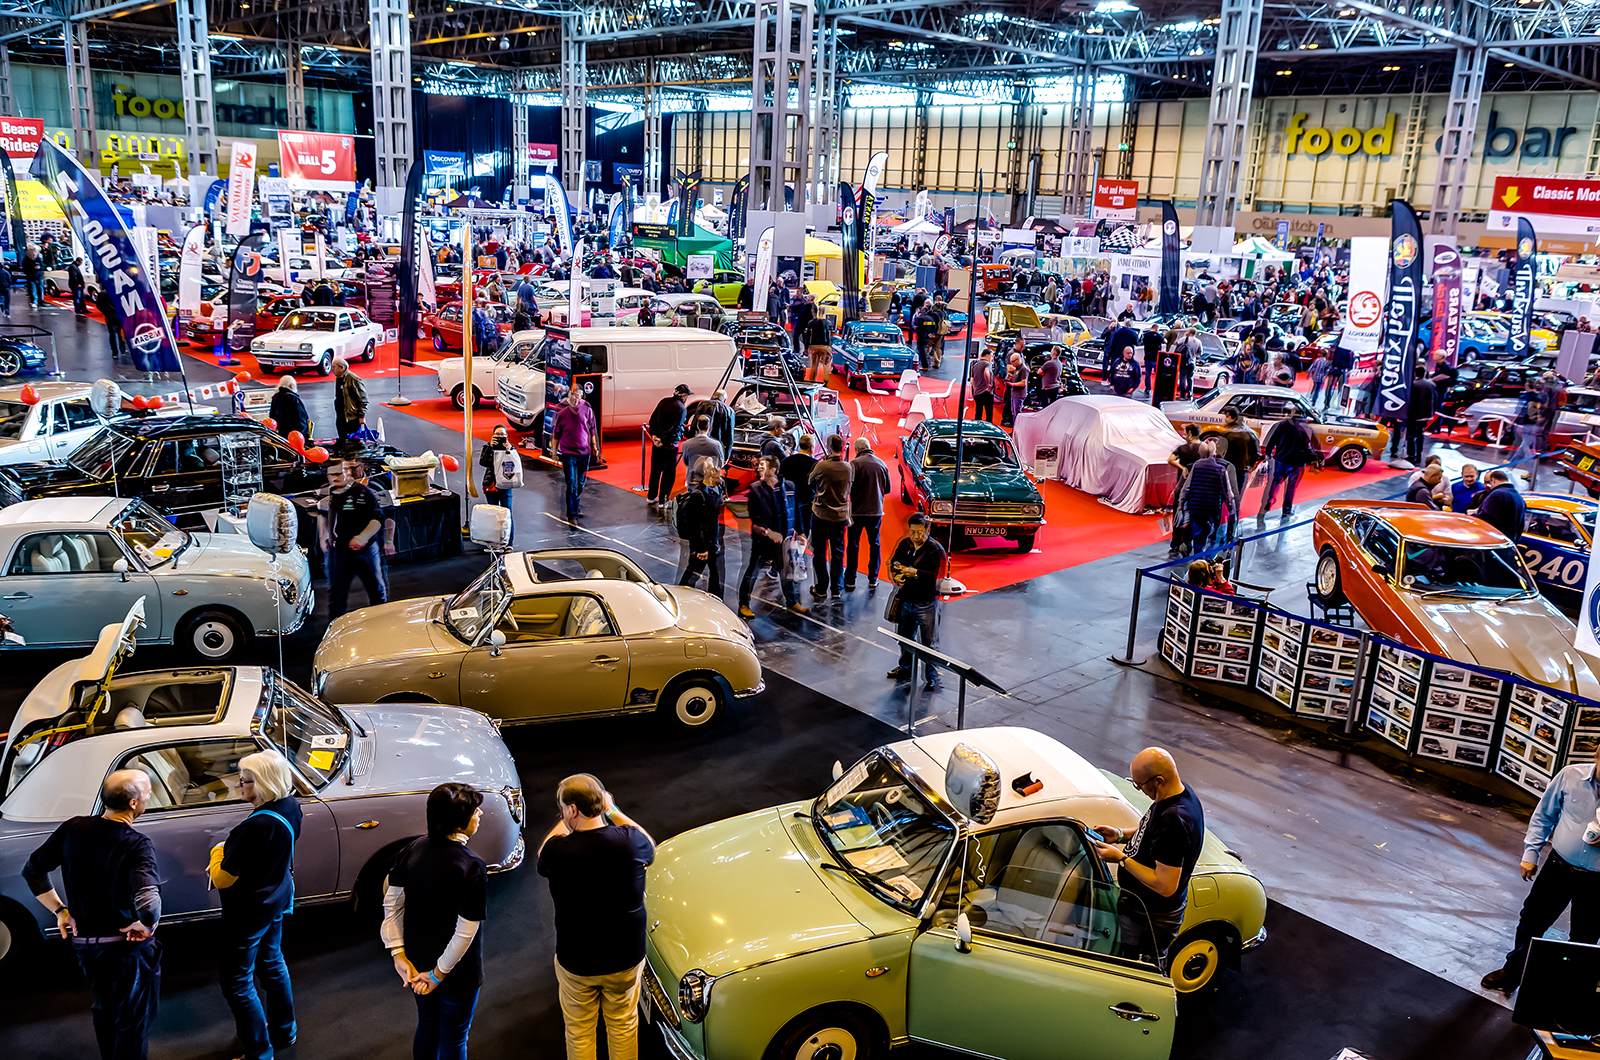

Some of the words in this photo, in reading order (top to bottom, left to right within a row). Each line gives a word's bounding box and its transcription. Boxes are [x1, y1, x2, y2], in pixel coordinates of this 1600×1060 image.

[1, 121, 38, 136] Bears
[1285, 112, 1397, 155] food
[1483, 110, 1577, 158] bar
[0, 136, 39, 153] Rides
[297, 154, 321, 166] HALL
[320, 149, 337, 175] 5
[430, 155, 462, 165] Discovery
[231, 170, 244, 223] VAUXHALL
[1098, 184, 1109, 195] Past
[1109, 185, 1118, 195] and
[1118, 186, 1136, 196] Present
[1533, 185, 1574, 200] Classic
[1188, 414, 1208, 422] DEALER
[966, 527, 983, 535] NWU
[985, 527, 1007, 535] 783D
[1524, 549, 1585, 585] 240
